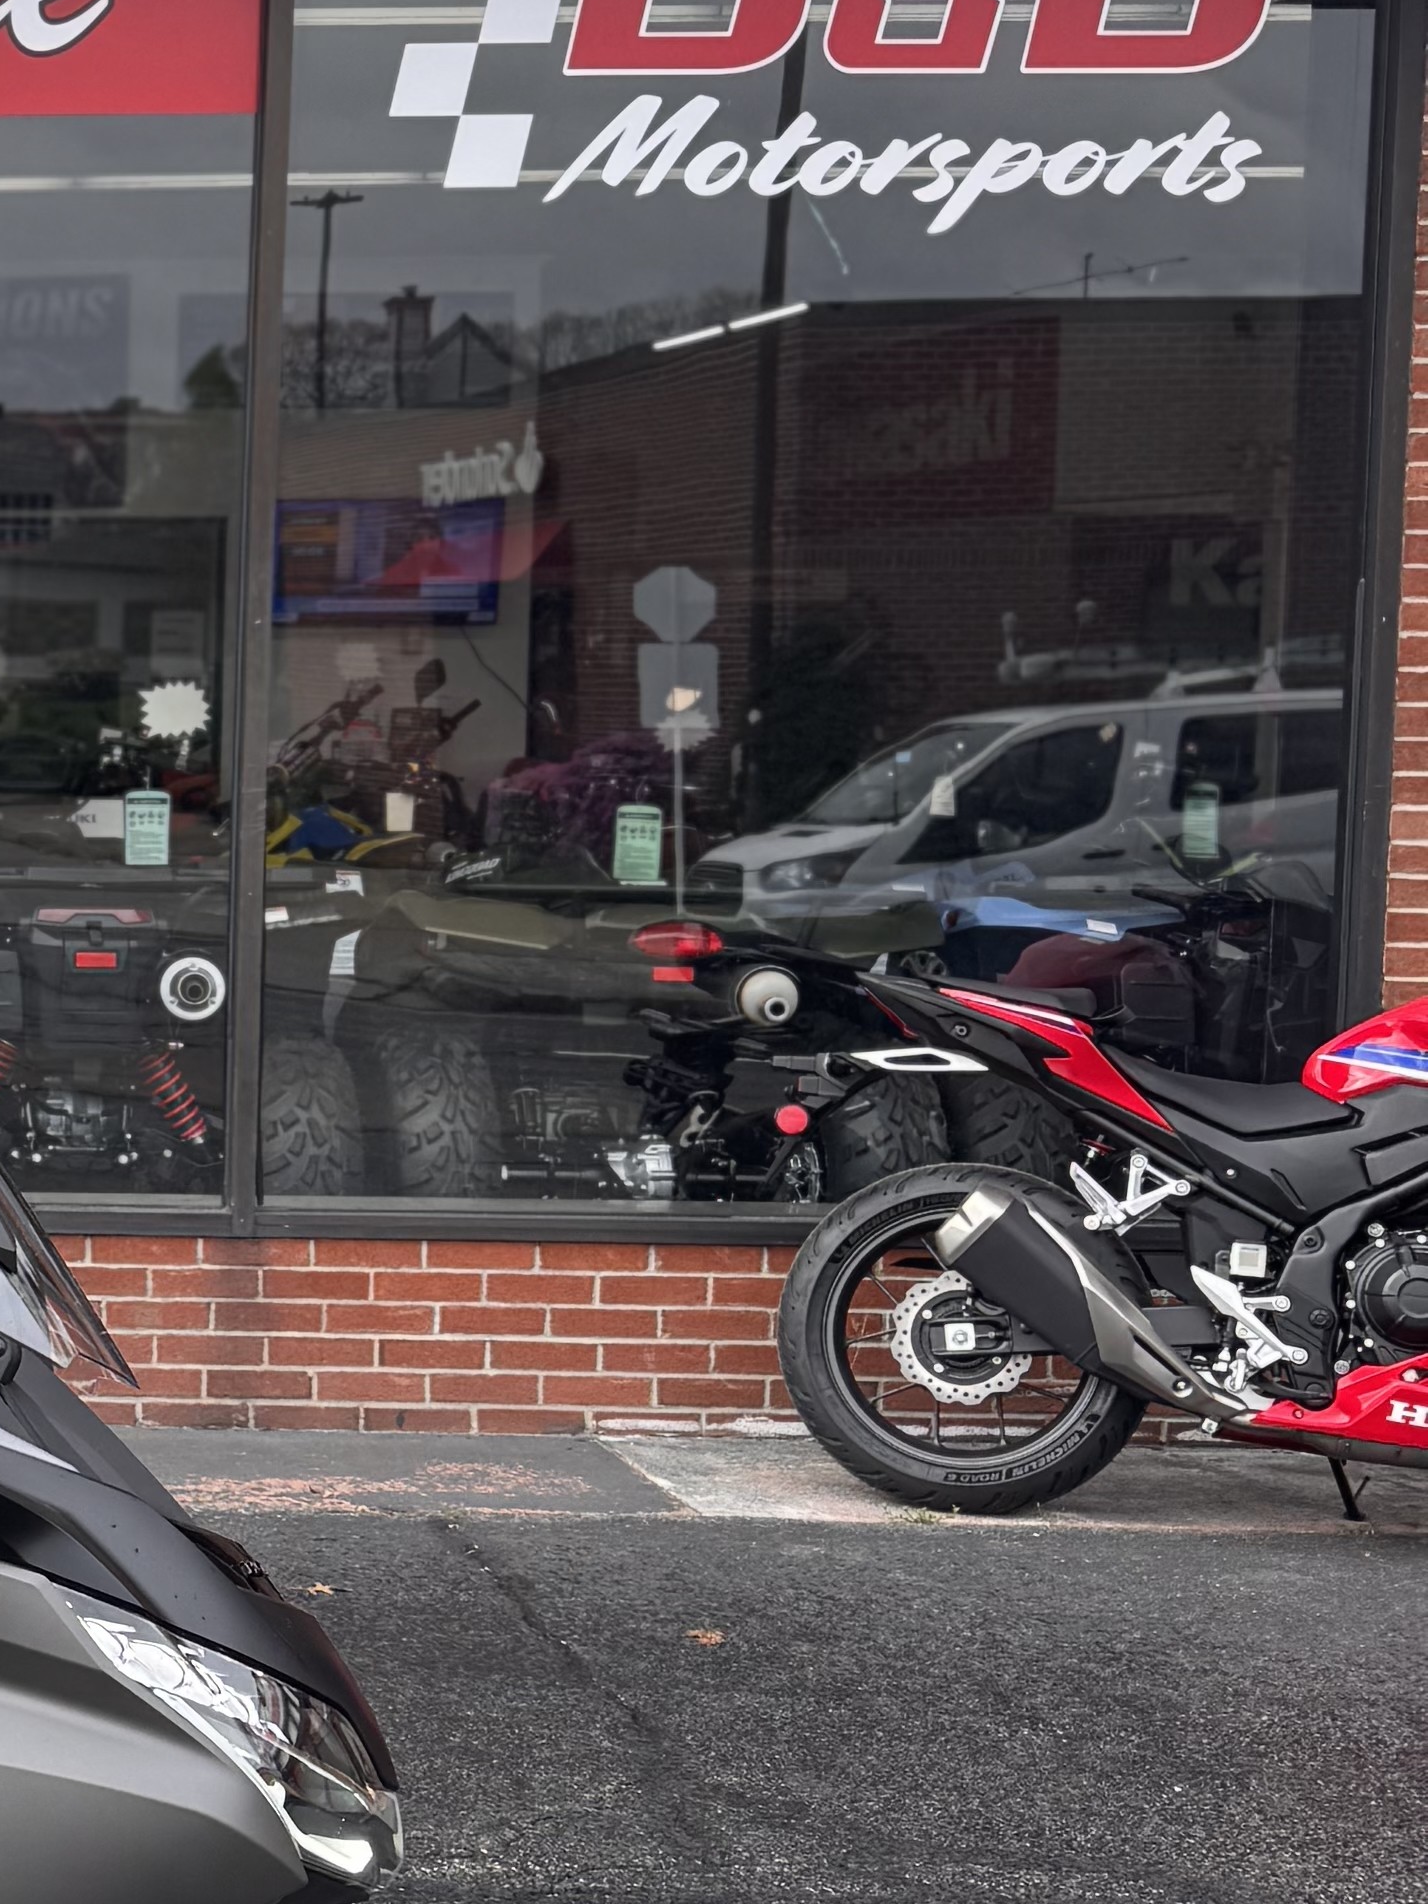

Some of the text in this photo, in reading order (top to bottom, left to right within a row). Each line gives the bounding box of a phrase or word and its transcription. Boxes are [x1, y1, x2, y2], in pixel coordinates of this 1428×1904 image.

[542, 94, 1264, 234] Motorsports
[958, 1471, 1001, 1483] ROAD
[1010, 1433, 1084, 1479] MICHELIN
